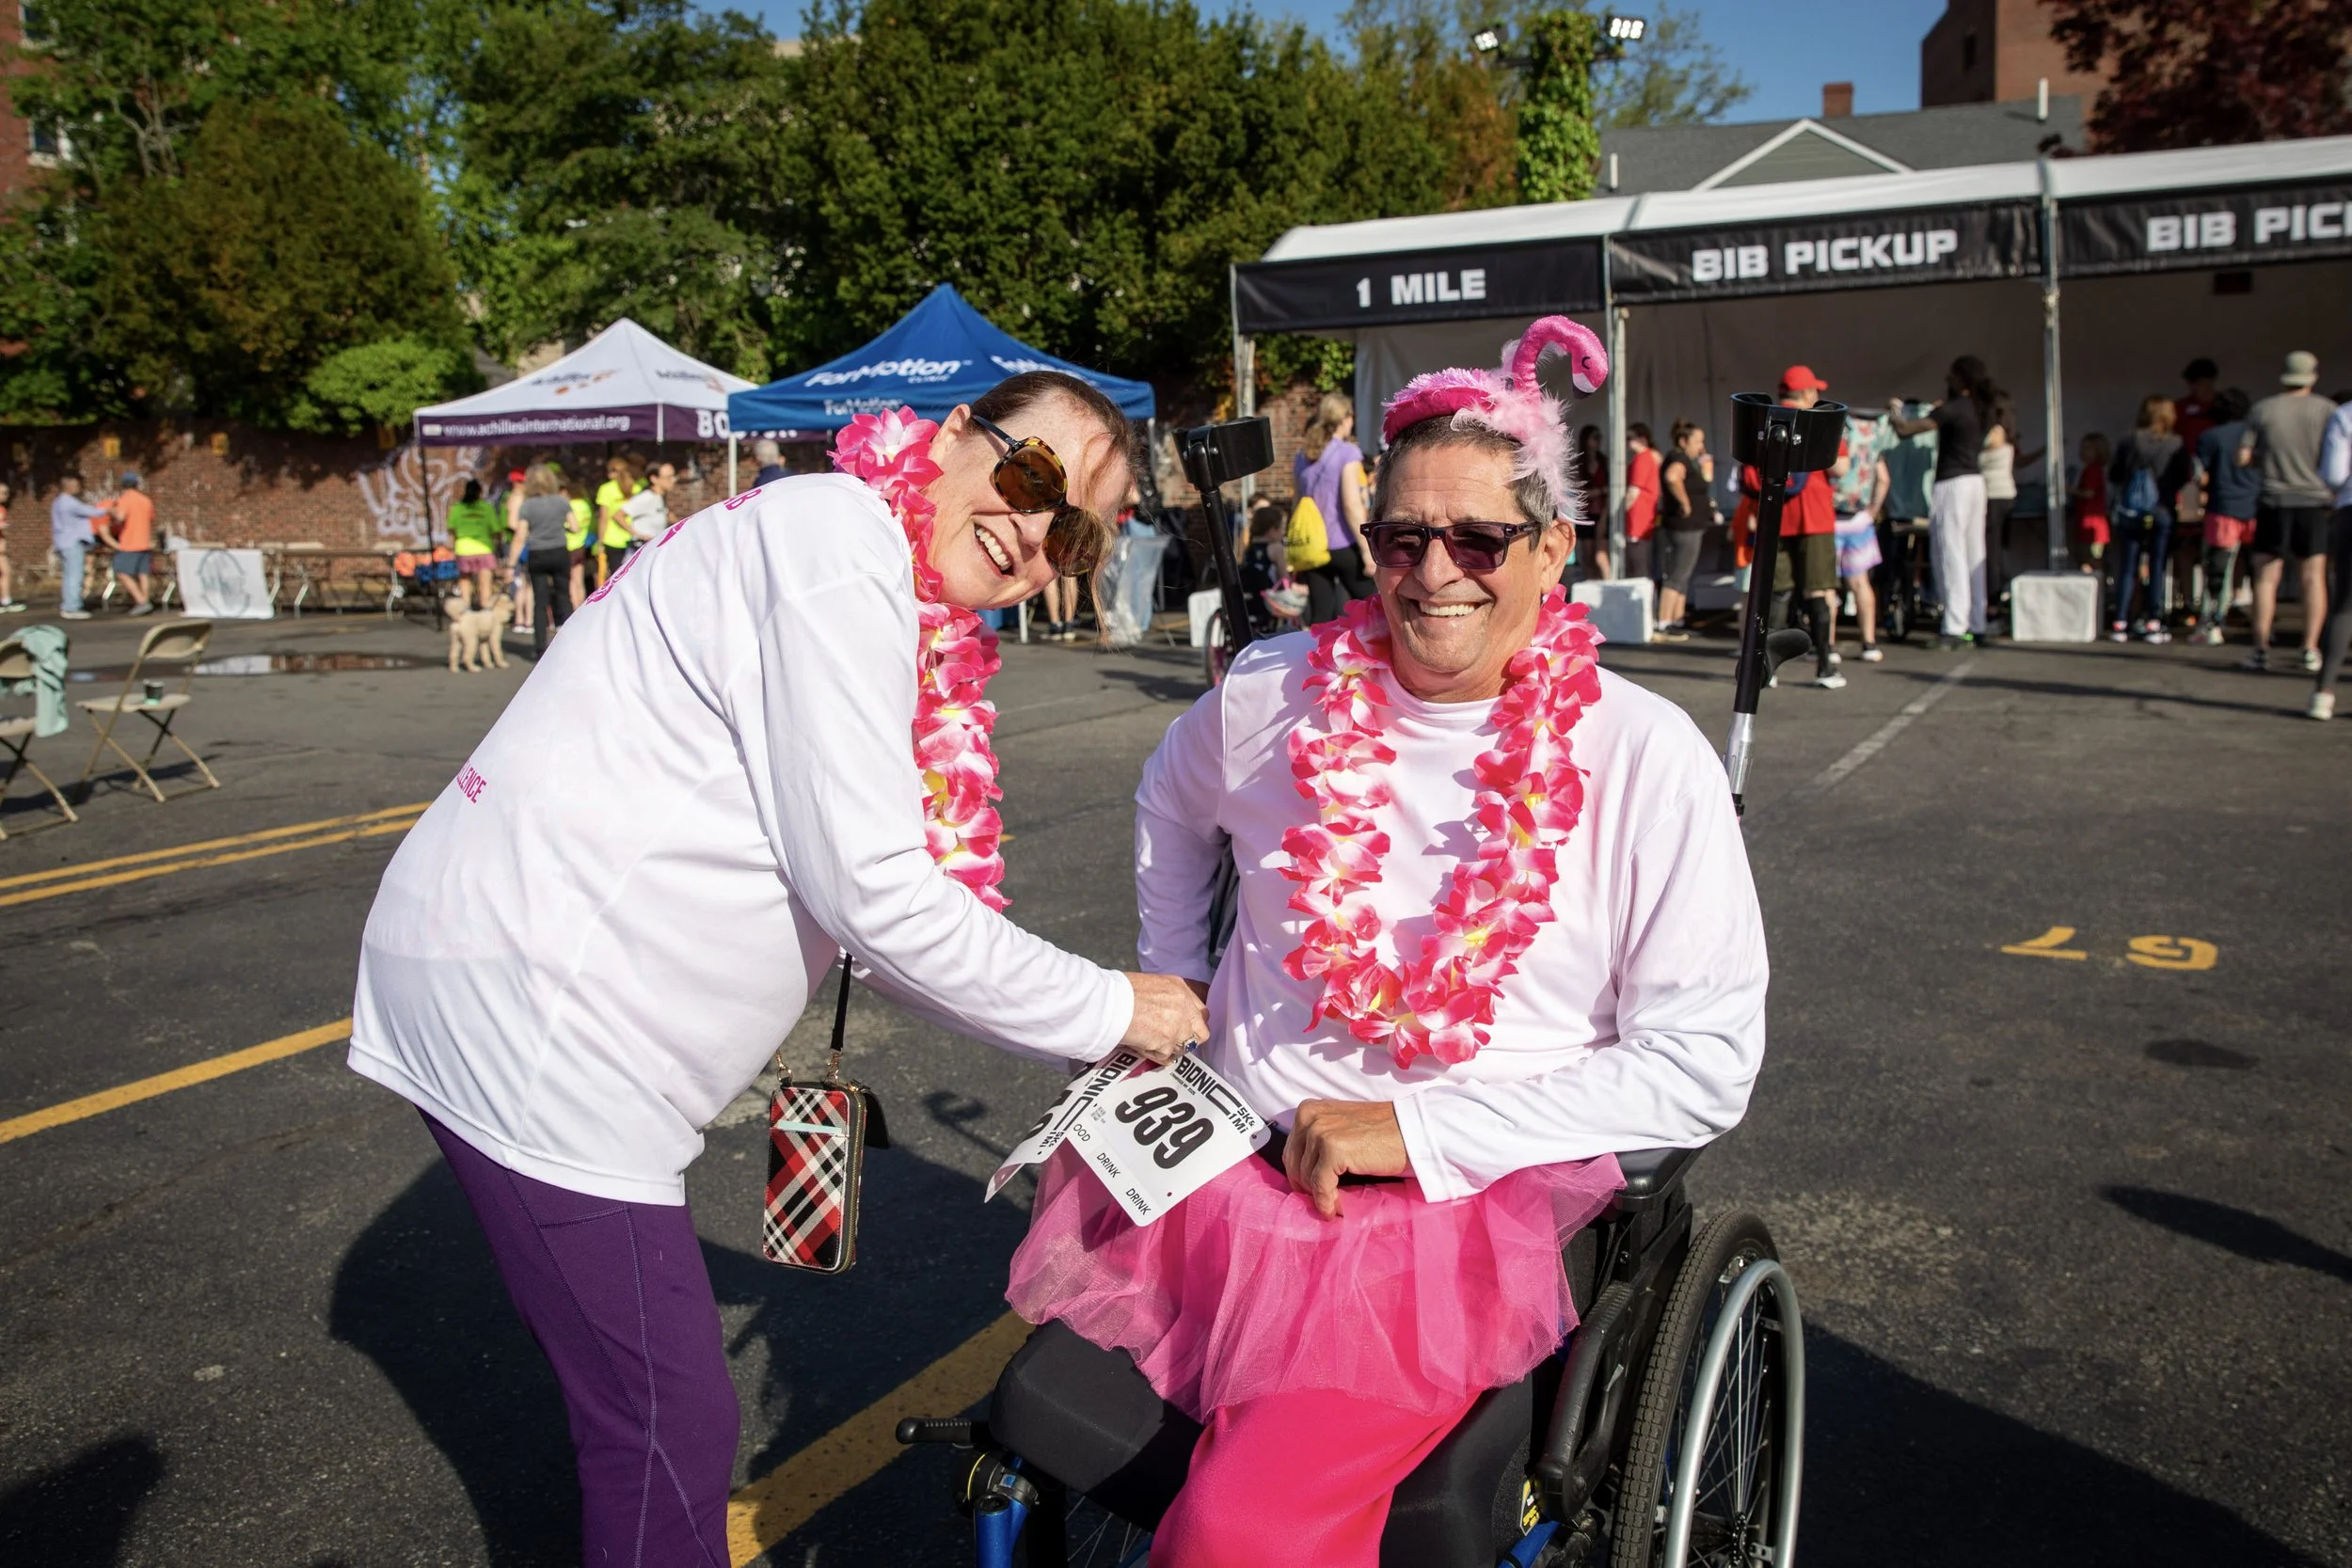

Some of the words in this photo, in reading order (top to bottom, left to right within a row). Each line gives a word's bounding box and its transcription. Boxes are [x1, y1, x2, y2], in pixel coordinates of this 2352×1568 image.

[2146, 211, 2236, 252] BIB
[2254, 200, 2352, 245] PIC
[1692, 245, 1769, 282] BIB
[1785, 229, 1958, 275] PICKUP
[1357, 277, 1371, 308] 1
[1391, 268, 1486, 306] MILE
[444, 414, 631, 437] www.achillesinternational.org
[1053, 1053, 1139, 1132] BIONIC
[1174, 1054, 1243, 1117] BIONIC
[1115, 1086, 1215, 1169] 939
[1073, 1123, 1091, 1142] OOD
[1096, 1152, 1120, 1179] DRINK
[1125, 1188, 1152, 1215] DRINK
